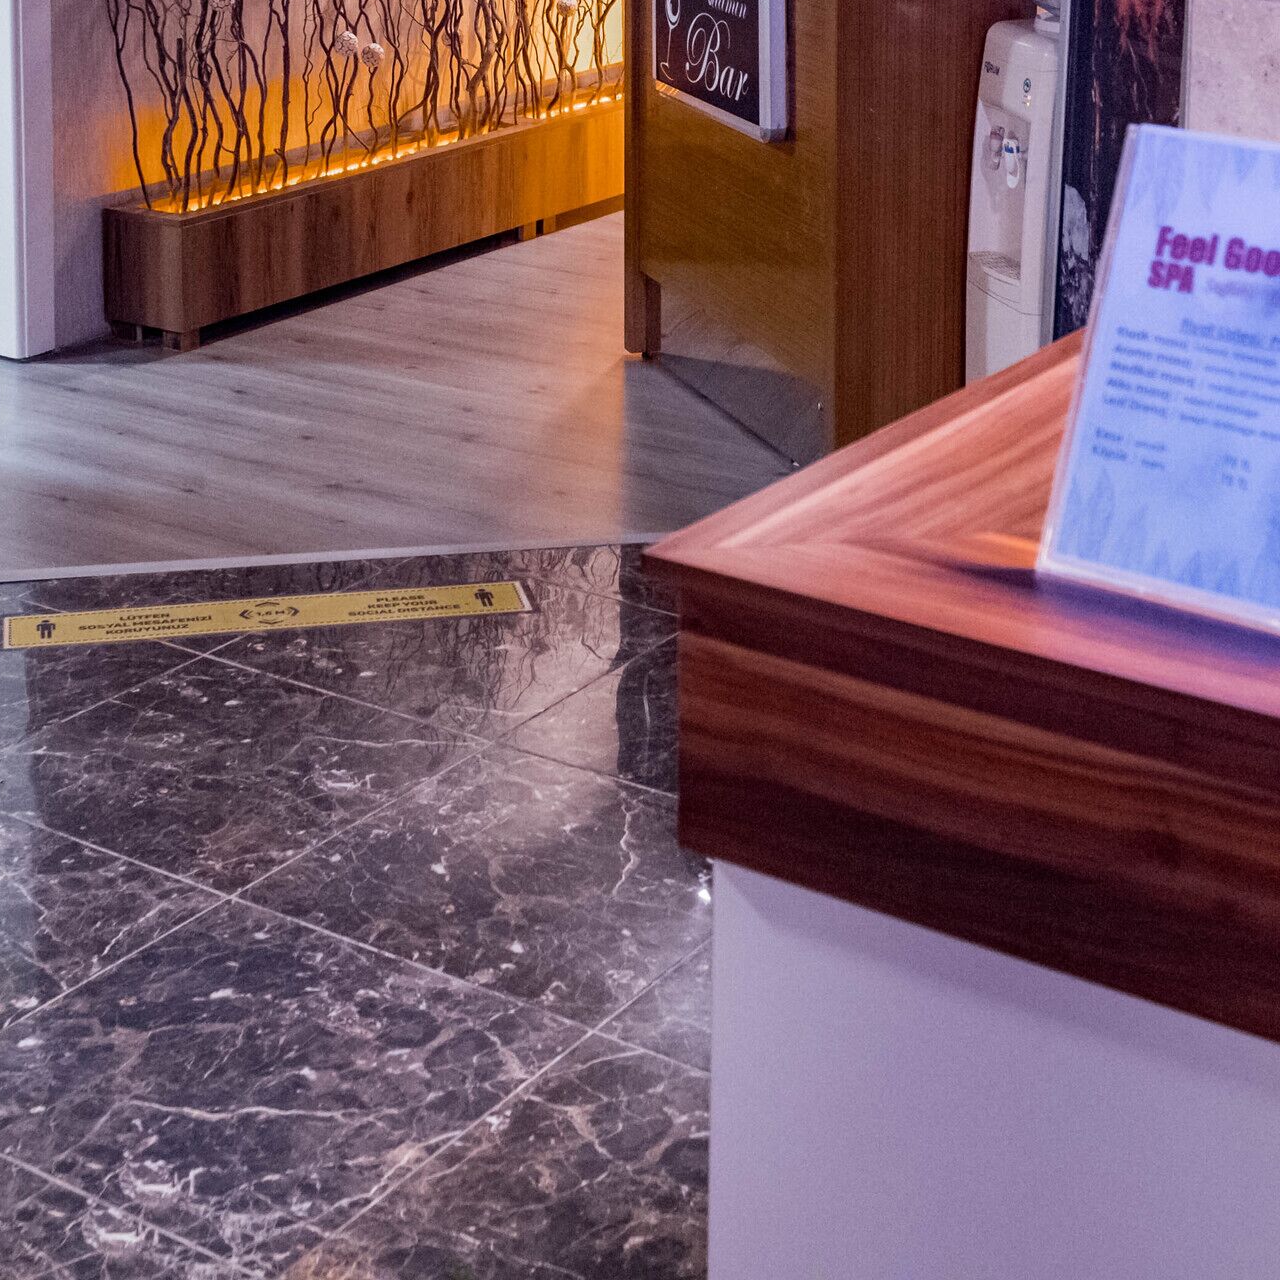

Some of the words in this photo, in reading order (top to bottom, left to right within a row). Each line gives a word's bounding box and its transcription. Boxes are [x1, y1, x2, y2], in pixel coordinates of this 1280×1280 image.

[686, 12, 749, 102] Bar
[1155, 226, 1219, 266] Feel
[1148, 260, 1195, 294] SPA
[376, 595, 426, 603] PLEASE
[402, 599, 438, 607] YOUR
[348, 608, 396, 617] SOCIAL
[398, 603, 461, 614] DISTANCE
[78, 621, 131, 631] SOSYAL
[105, 623, 190, 635] KORUYUNUZ
